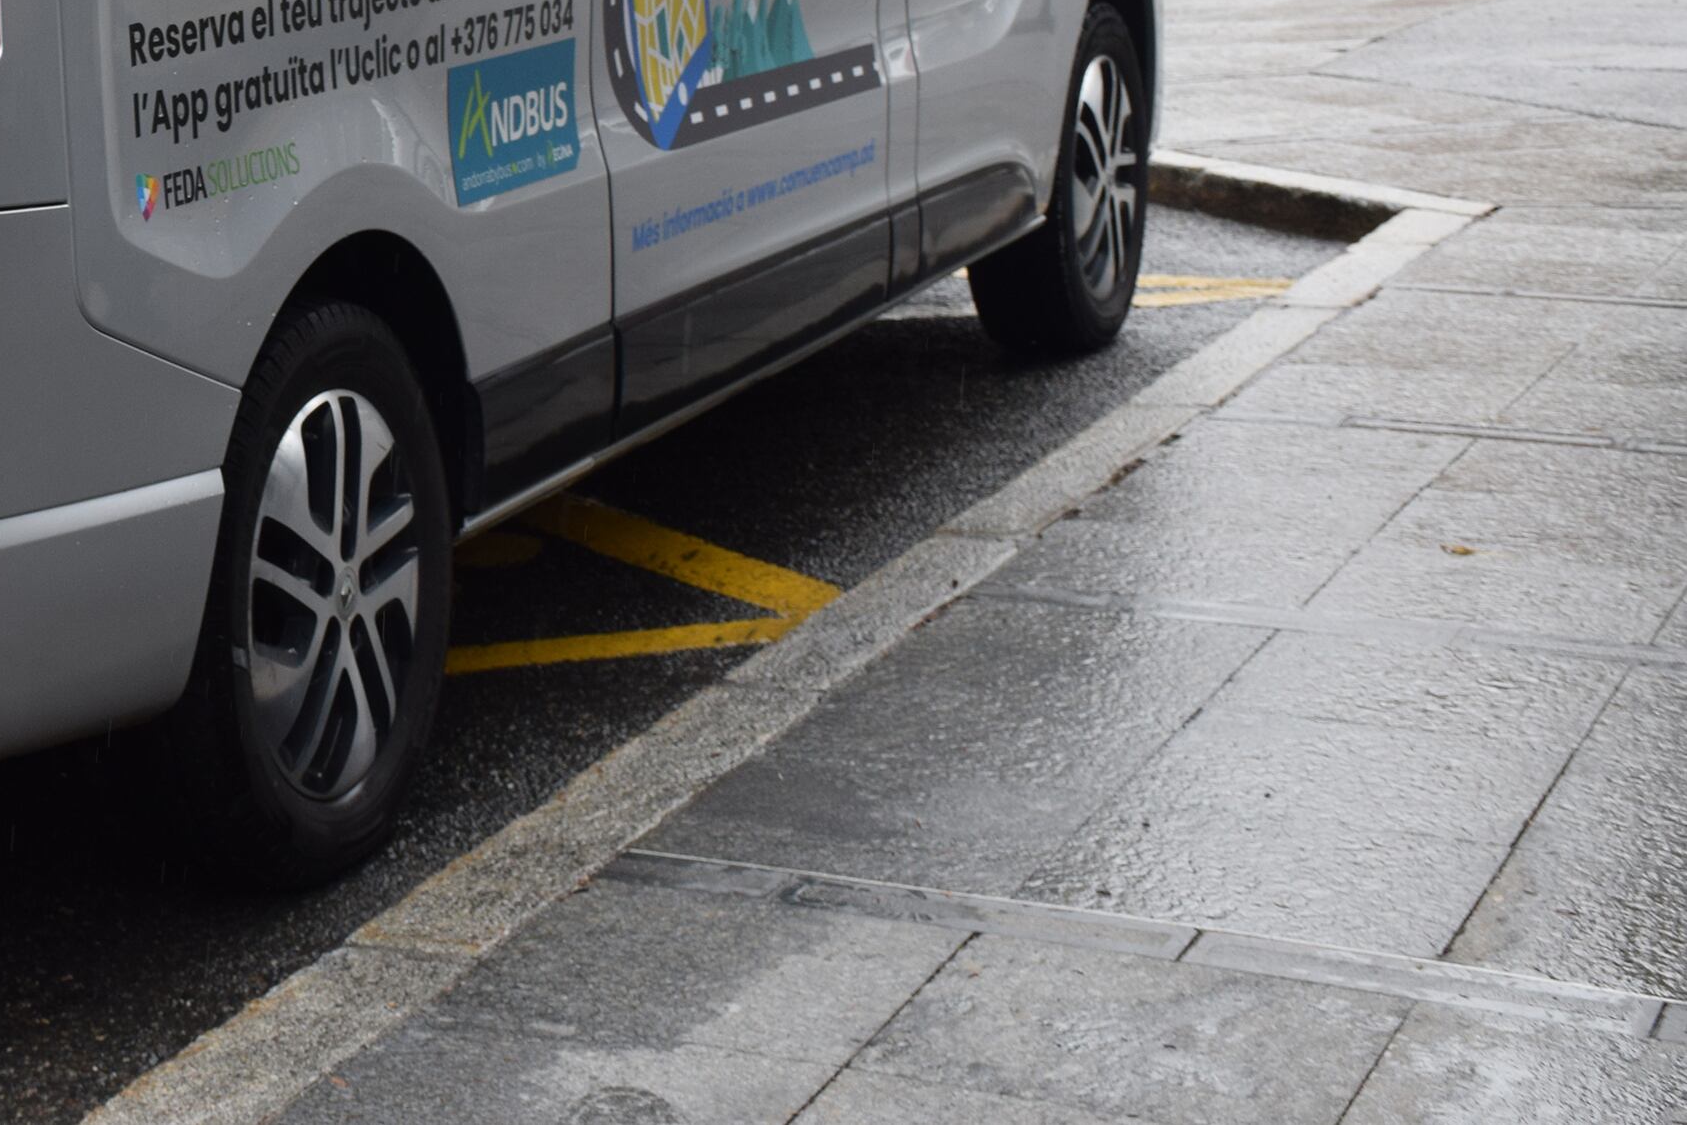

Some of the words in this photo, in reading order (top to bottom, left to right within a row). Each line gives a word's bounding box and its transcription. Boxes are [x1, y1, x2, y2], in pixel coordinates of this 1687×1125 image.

[129, 10, 245, 67] Reserva
[132, 88, 208, 144] l'App
[214, 55, 325, 133] gratuïta
[330, 34, 401, 90] l'Uclic
[407, 38, 420, 70] o
[425, 24, 445, 66] al
[451, 12, 498, 56] +376
[504, 3, 535, 47] 775
[458, 69, 569, 160] ANDBUS
[632, 218, 660, 252] Més
[663, 187, 734, 241] informació
[736, 191, 744, 213] a
